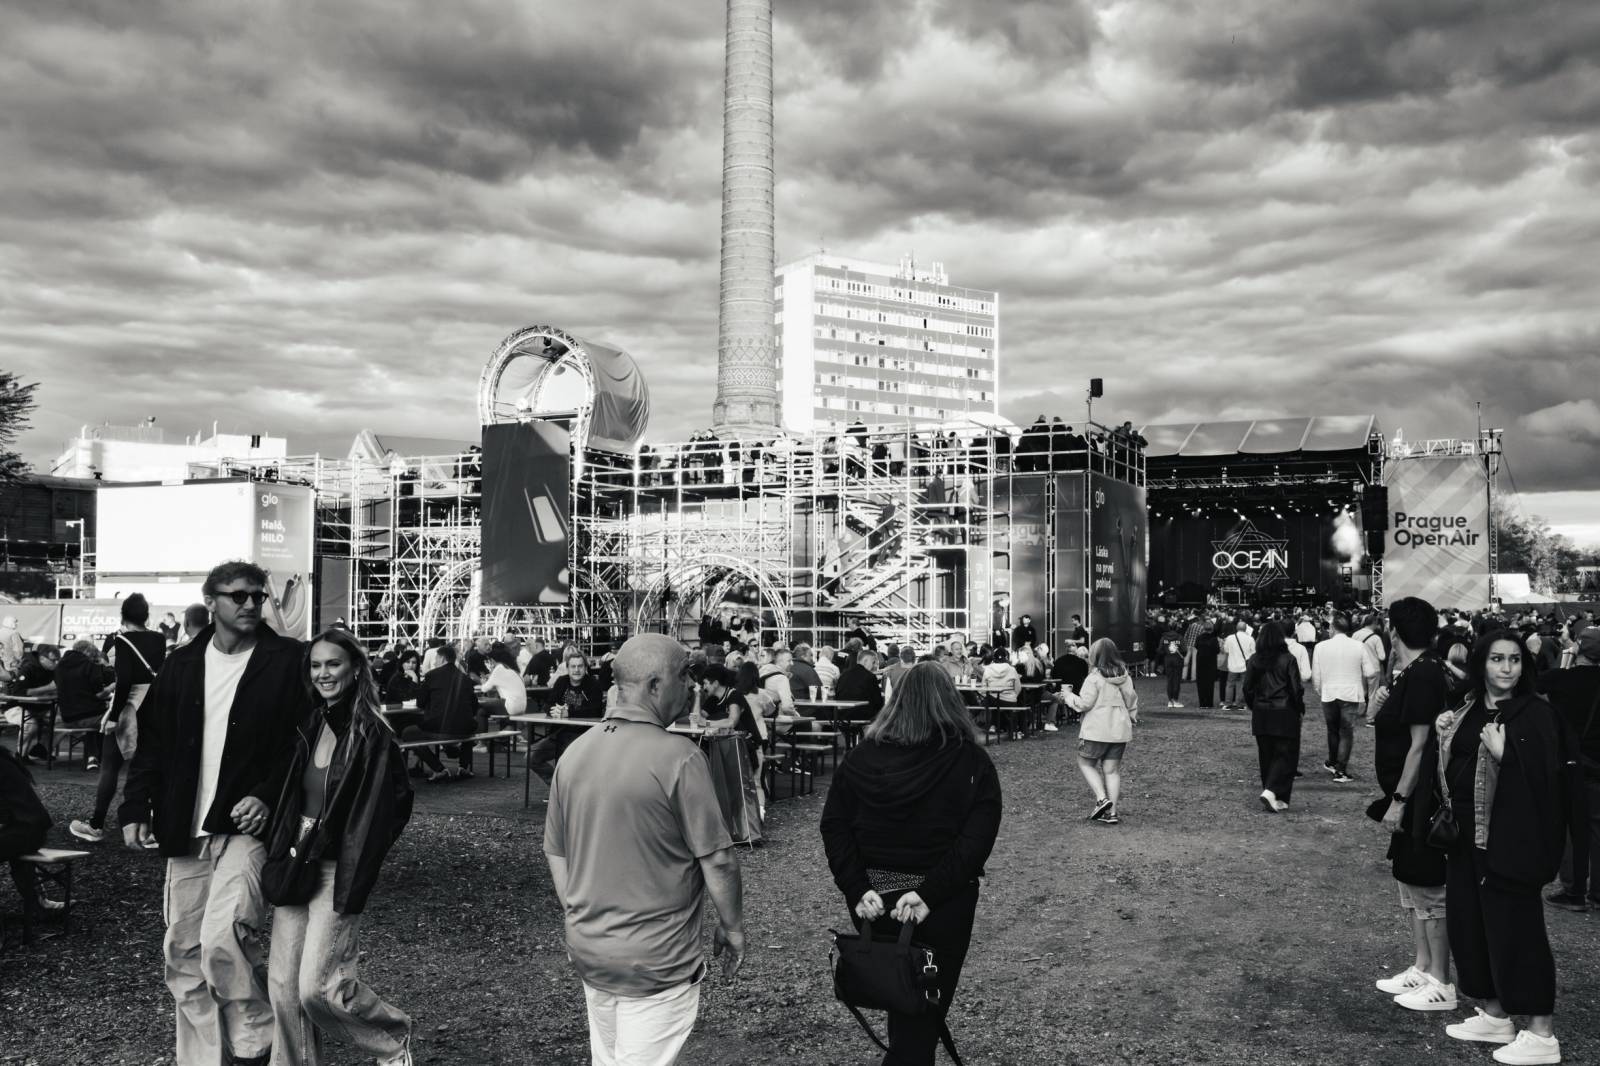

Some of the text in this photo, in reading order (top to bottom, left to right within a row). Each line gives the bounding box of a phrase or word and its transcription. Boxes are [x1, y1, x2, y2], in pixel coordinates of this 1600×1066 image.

[261, 492, 279, 507] glo
[1395, 512, 1467, 532] Prague
[1394, 529, 1480, 549] OpenAir
[1212, 548, 1288, 569] OCEAN
